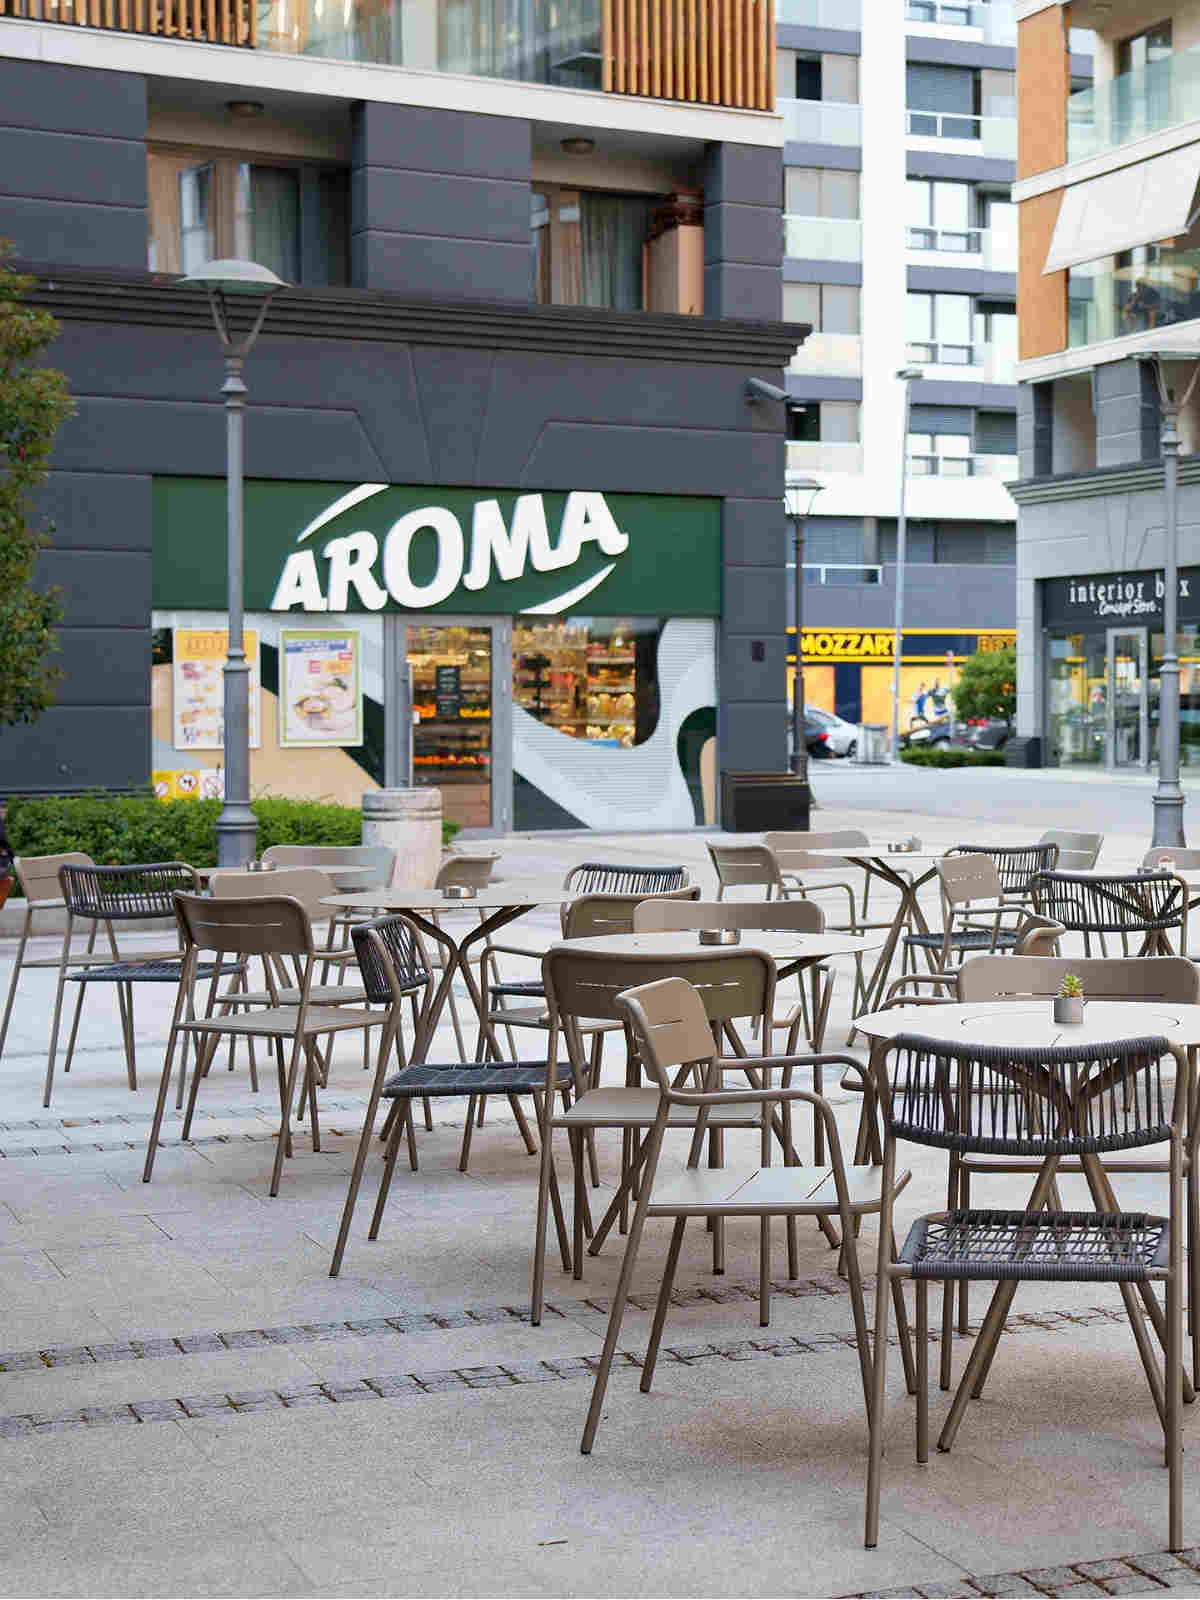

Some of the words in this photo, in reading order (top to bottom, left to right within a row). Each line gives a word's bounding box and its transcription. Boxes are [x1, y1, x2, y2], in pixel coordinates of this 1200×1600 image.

[270, 490, 630, 611] AROMA
[1069, 579, 1144, 603] interior
[1155, 571, 1189, 598] bx
